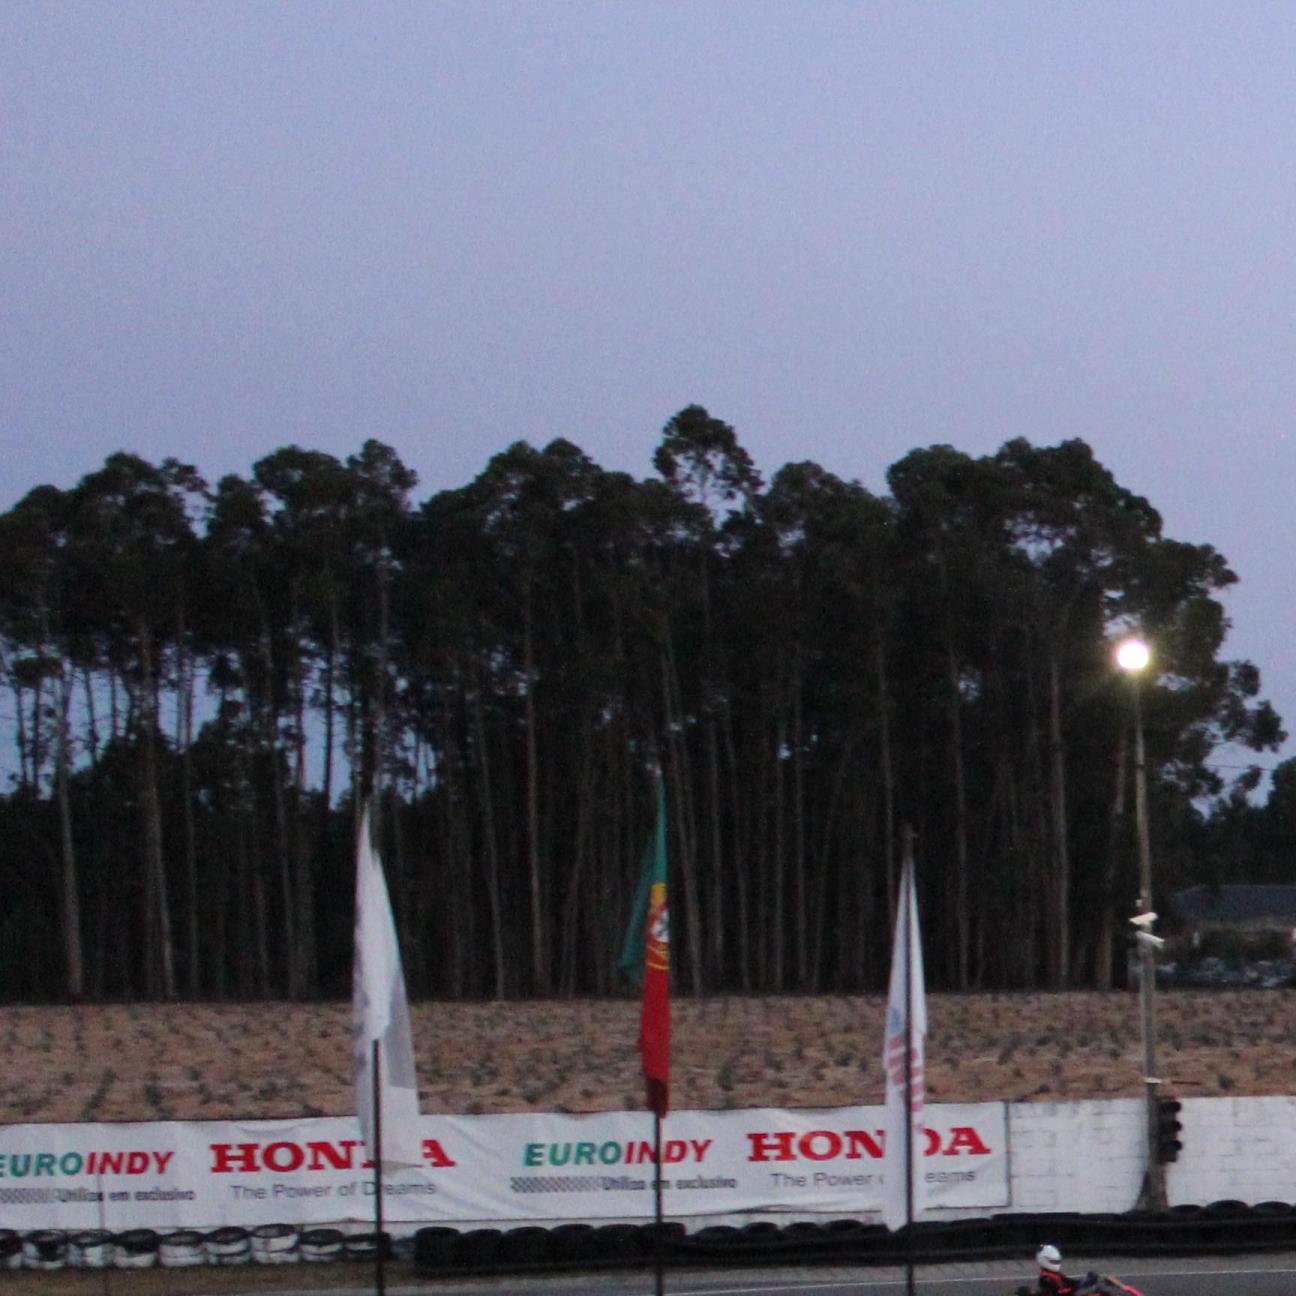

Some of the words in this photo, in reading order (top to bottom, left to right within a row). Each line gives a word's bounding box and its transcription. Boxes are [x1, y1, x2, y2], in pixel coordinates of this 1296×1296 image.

[209, 1139, 456, 1173] HONA
[523, 1139, 712, 1167] EUROINDY
[0, 1152, 174, 1177] UROINDY
[770, 1173, 806, 1187] The
[813, 1172, 873, 1187] Power
[925, 1171, 976, 1184] eams
[231, 1185, 265, 1199] The
[273, 1183, 331, 1198] Power
[340, 1181, 358, 1197] of
[363, 1180, 436, 1197] Deams
